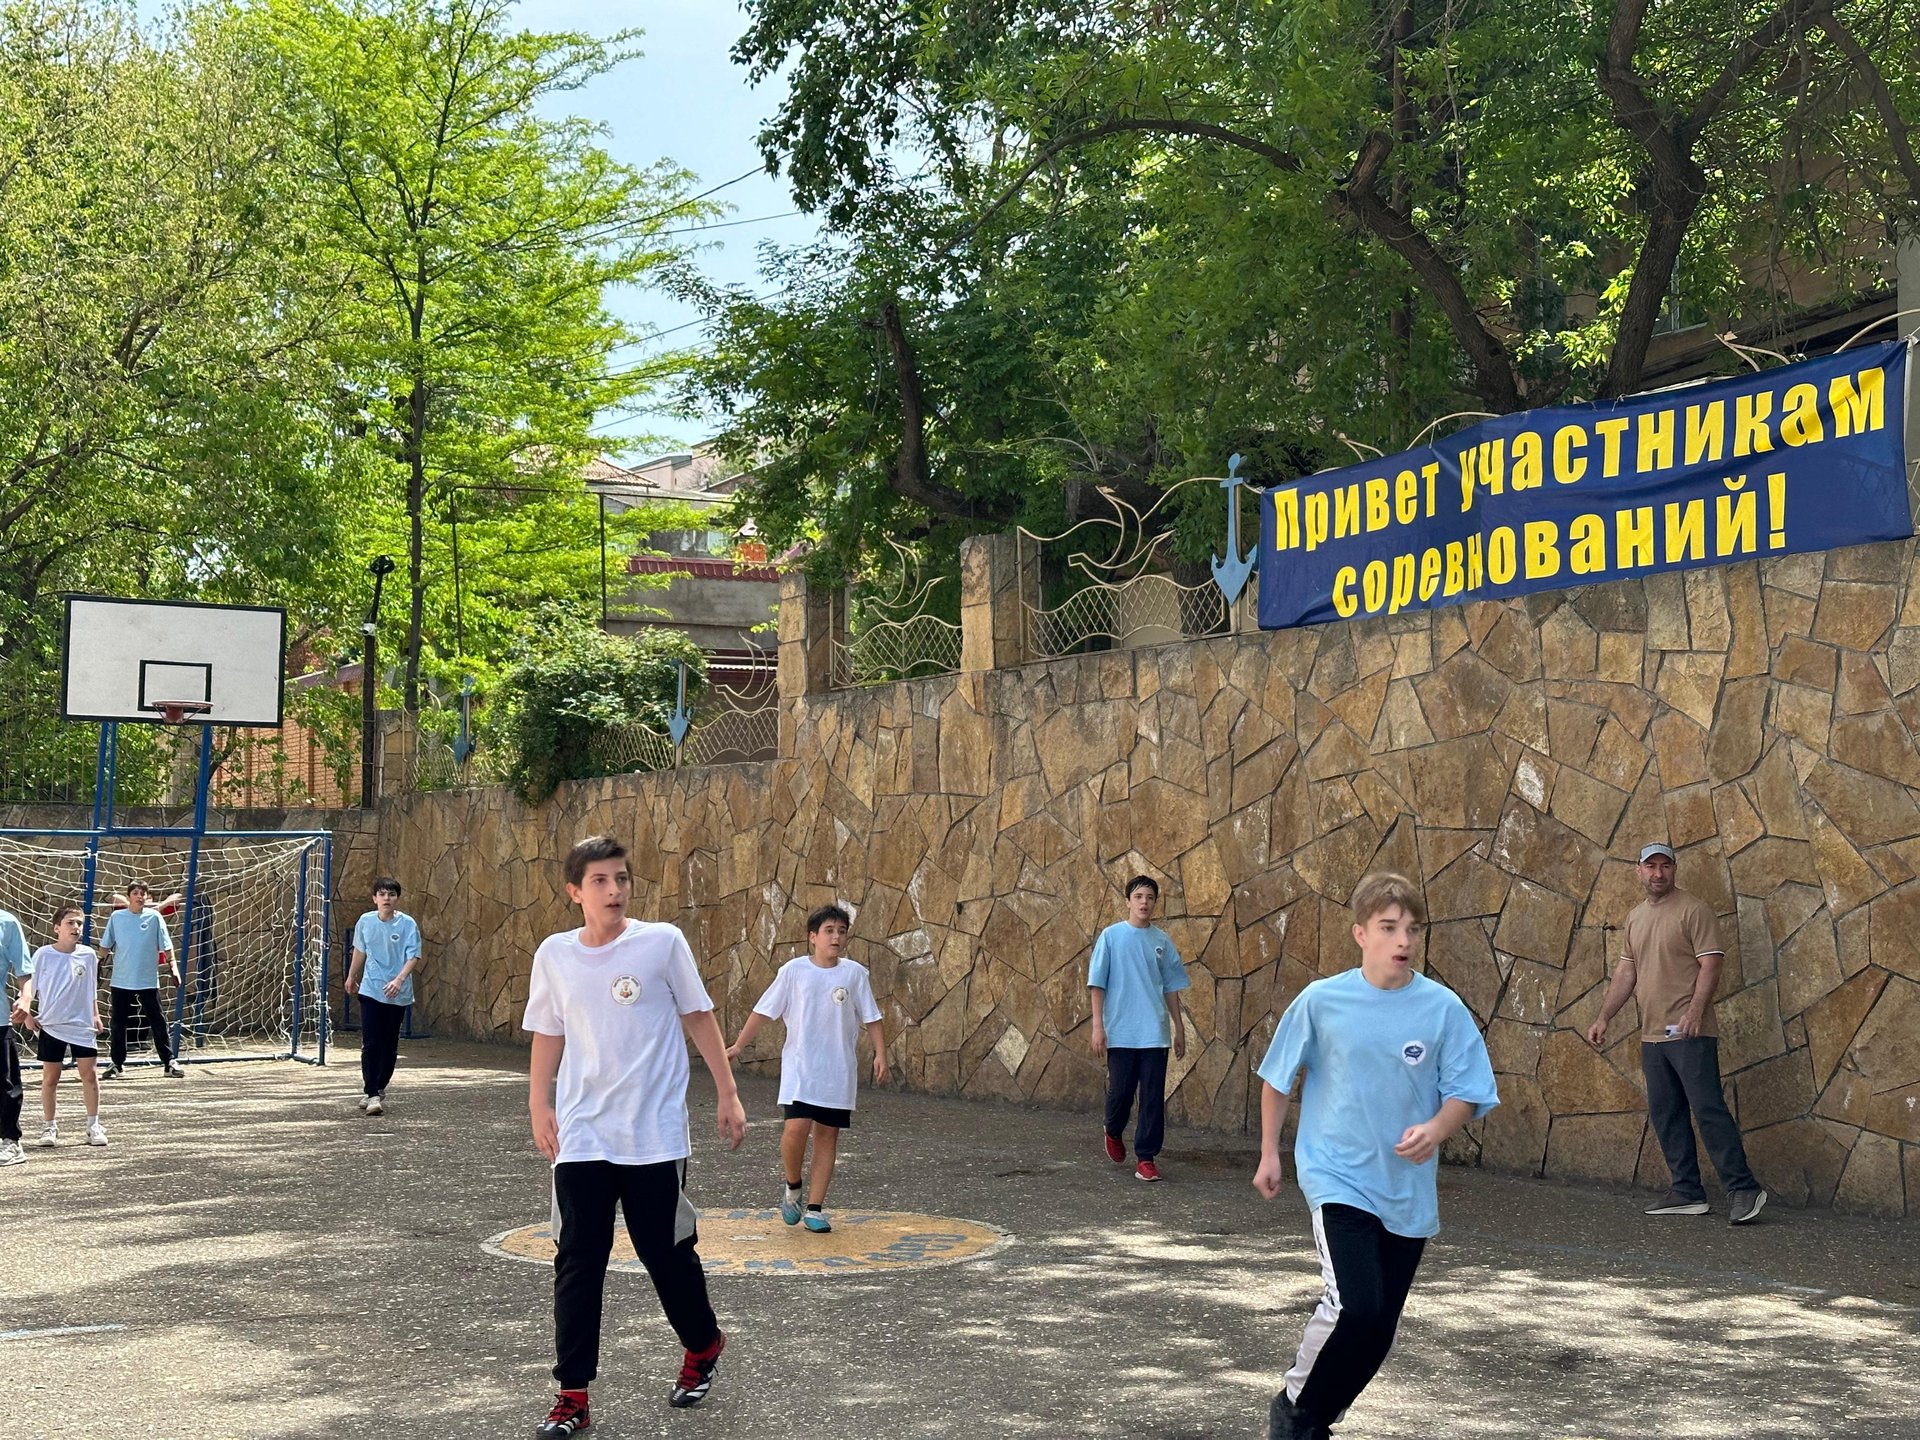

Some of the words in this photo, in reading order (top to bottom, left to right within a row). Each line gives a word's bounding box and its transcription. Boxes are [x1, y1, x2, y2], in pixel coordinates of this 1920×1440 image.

[1273, 461, 1440, 552] Привет
[1459, 366, 1886, 511] участникам
[1331, 472, 1787, 618] соревнований!
